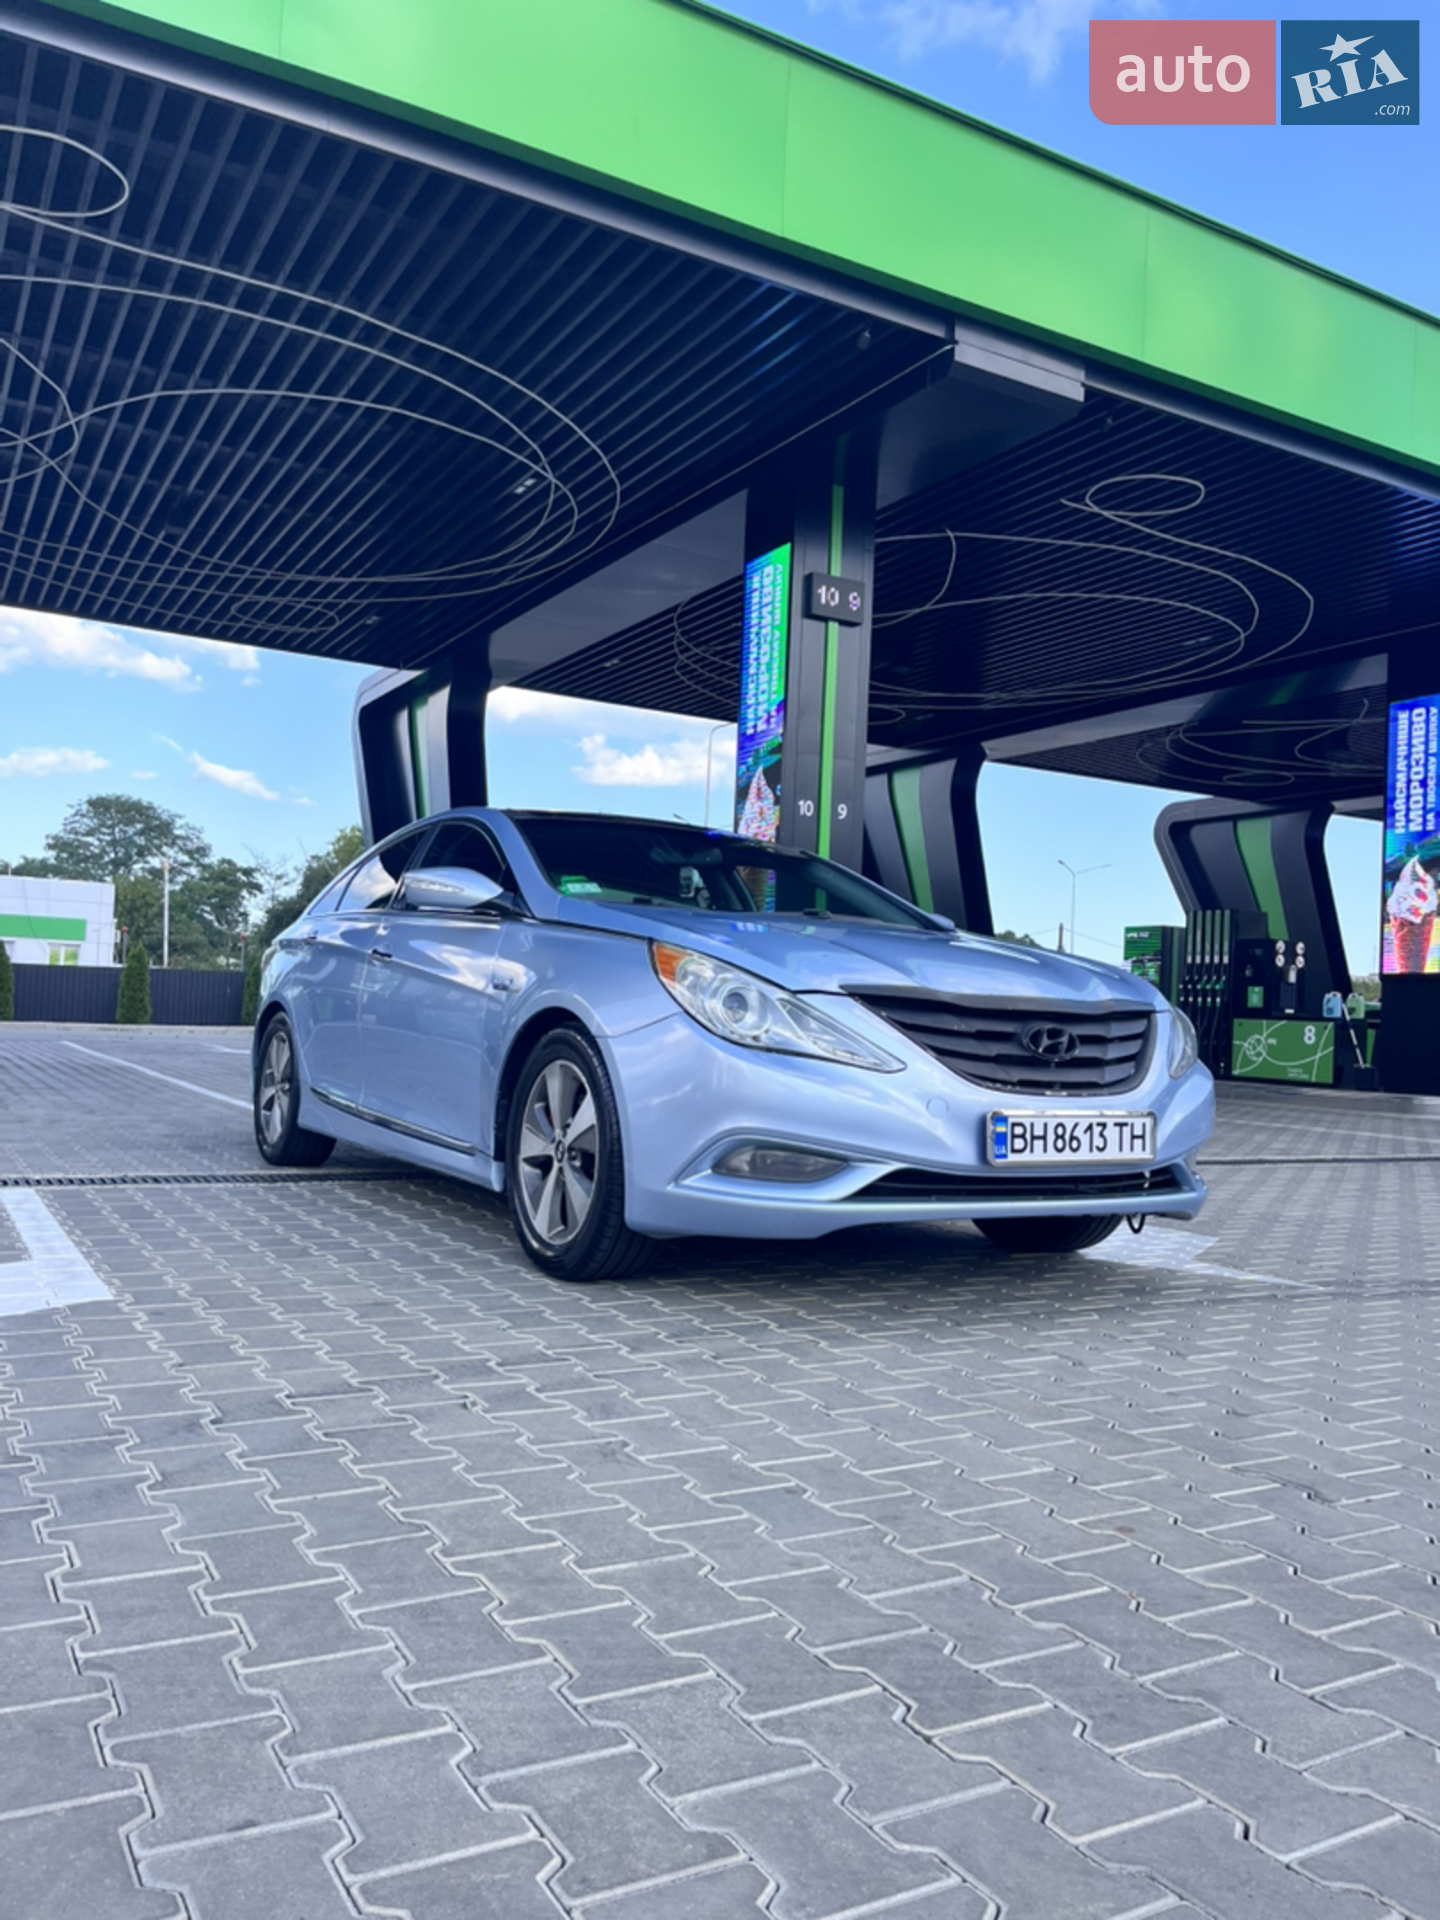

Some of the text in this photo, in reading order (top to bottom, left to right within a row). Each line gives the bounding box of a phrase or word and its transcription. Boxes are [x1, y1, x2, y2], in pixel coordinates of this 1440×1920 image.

[817, 585, 861, 611] 10 9
[1408, 707, 1426, 832] МОРОЗИВО
[798, 800, 814, 816] 10
[837, 804, 847, 820] 9
[1426, 812, 1436, 831] НА
[1304, 1025, 1316, 1045] 8
[1010, 1122, 1146, 1154] BH 8613 TH
